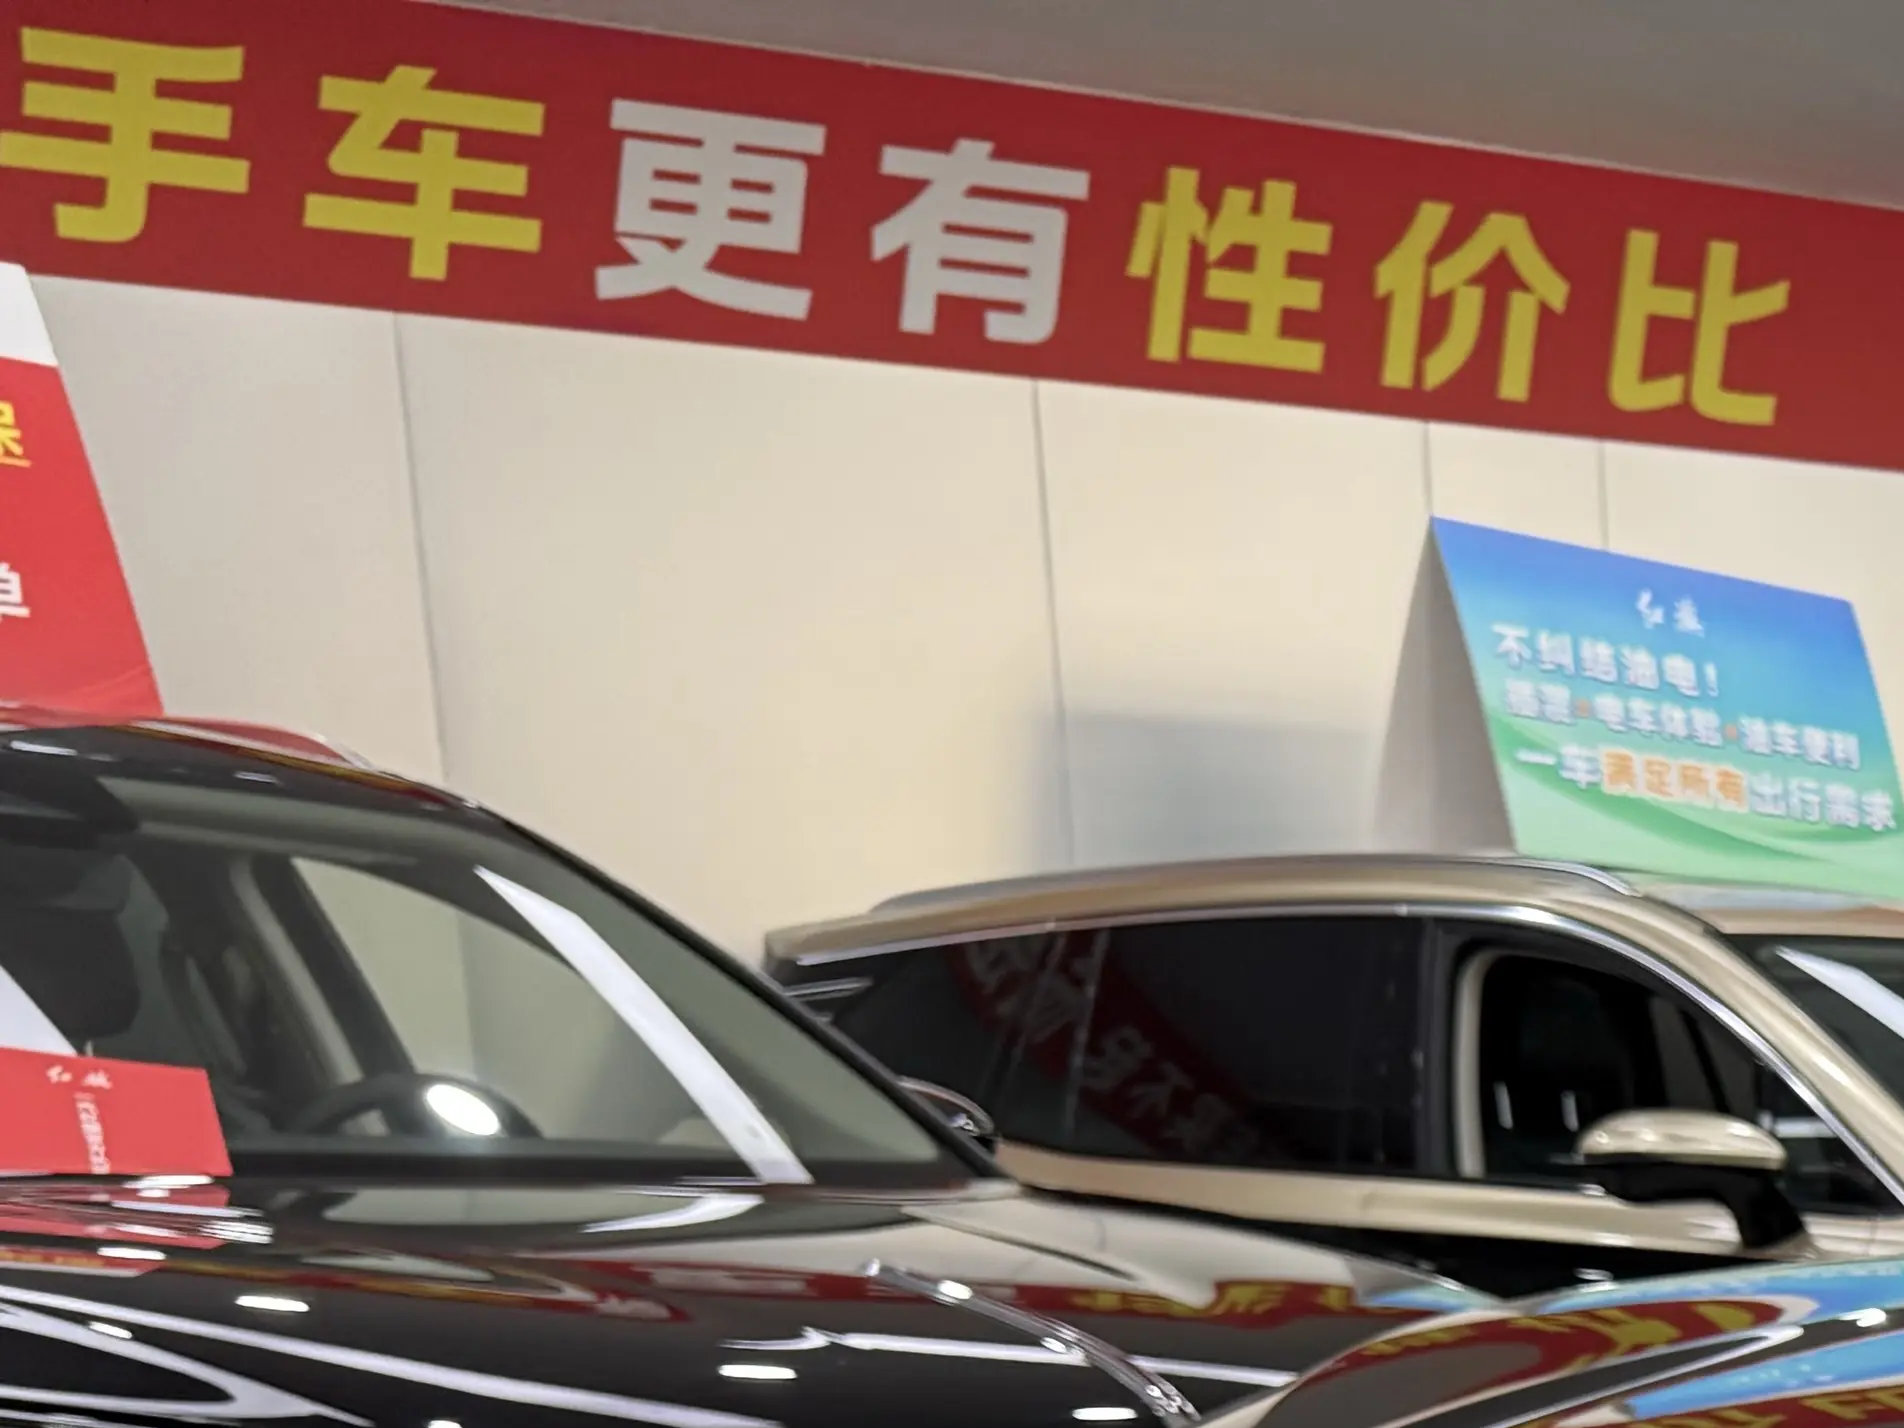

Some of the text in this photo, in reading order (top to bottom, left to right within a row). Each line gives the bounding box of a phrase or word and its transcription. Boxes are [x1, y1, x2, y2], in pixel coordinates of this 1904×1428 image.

[0, 26, 1791, 426] 手车更有性价比
